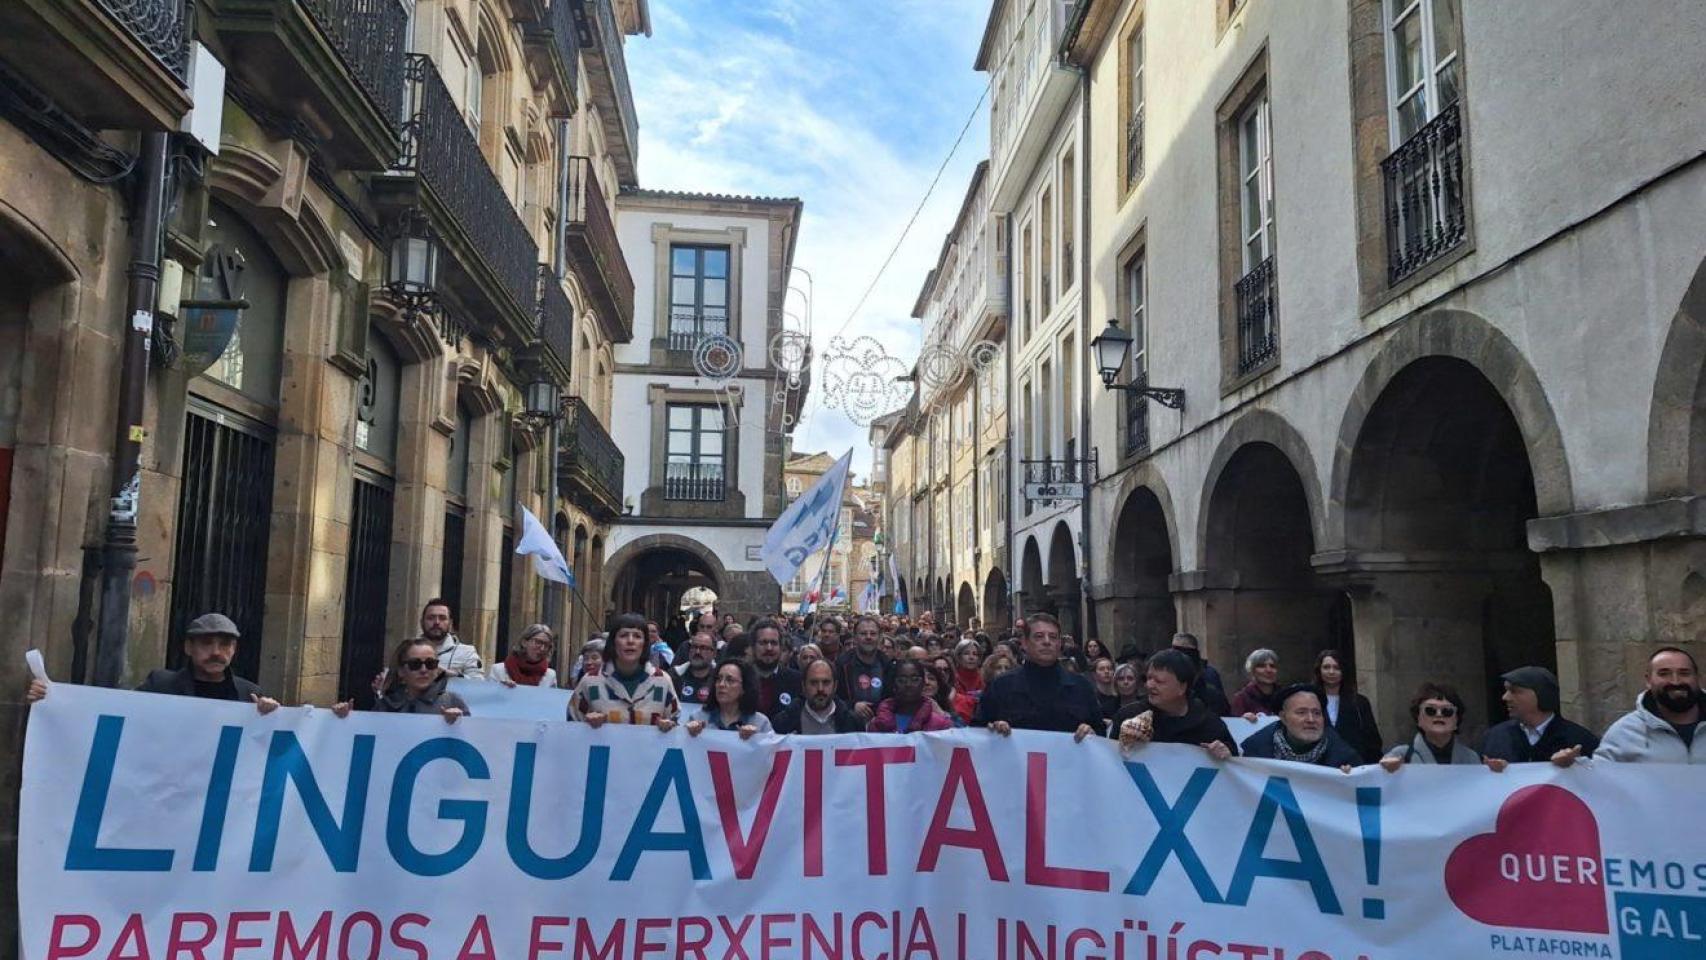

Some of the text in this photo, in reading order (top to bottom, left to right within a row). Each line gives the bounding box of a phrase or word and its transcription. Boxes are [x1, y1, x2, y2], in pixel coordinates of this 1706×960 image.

[47, 911, 430, 960] PAREMOS
[456, 914, 498, 960] A
[527, 906, 939, 960] EMERXENCIA
[1490, 933, 1613, 960] PLATAFORMA
